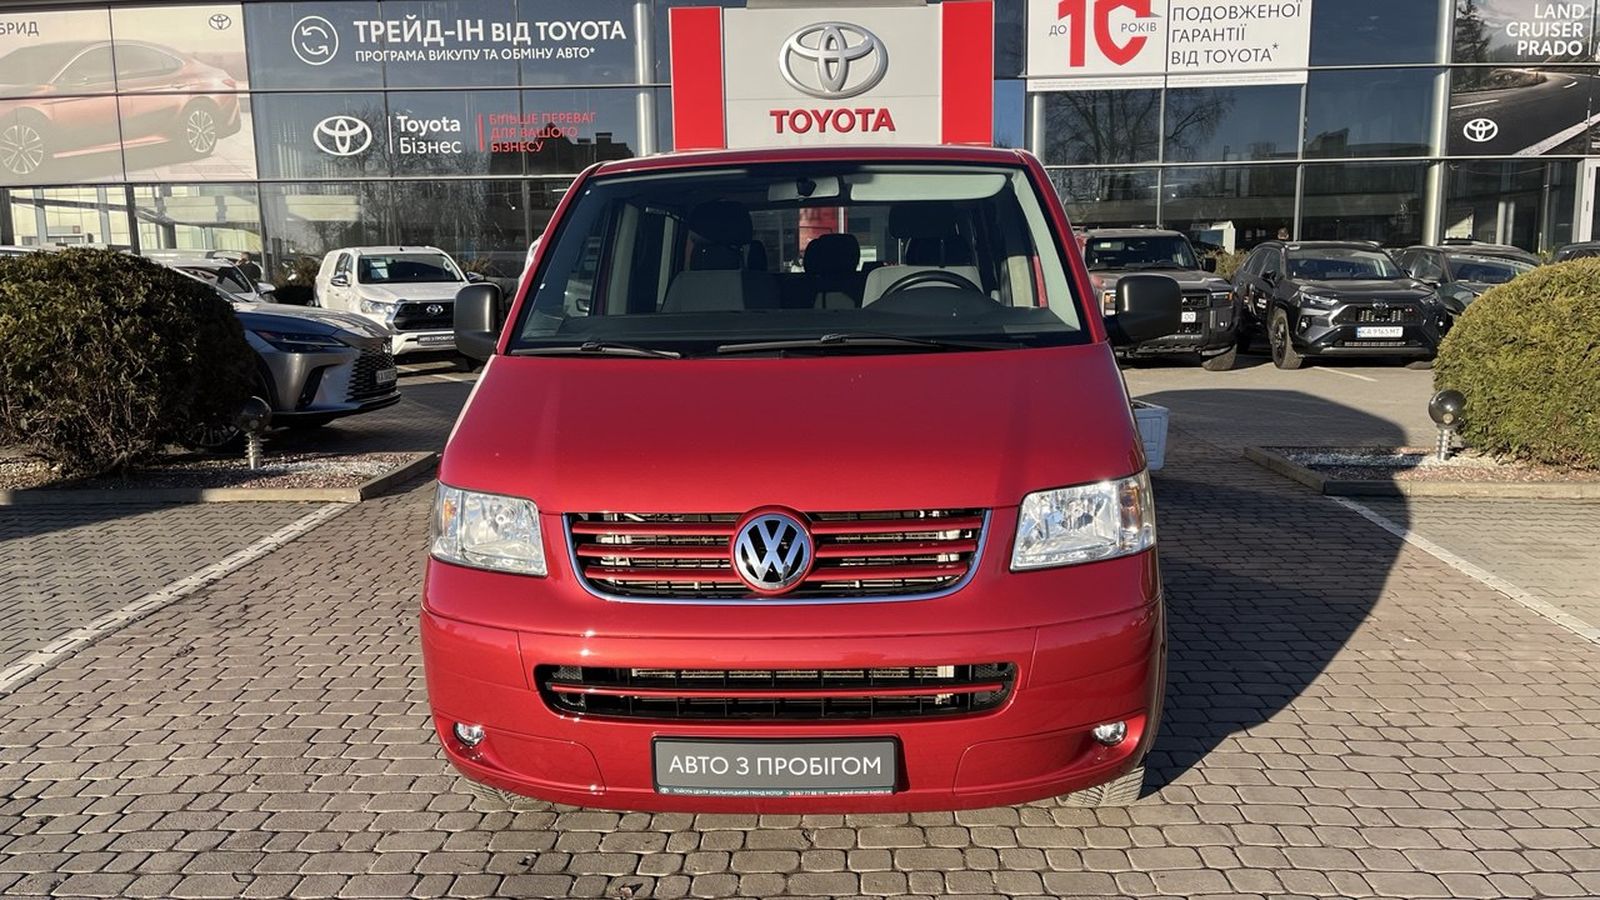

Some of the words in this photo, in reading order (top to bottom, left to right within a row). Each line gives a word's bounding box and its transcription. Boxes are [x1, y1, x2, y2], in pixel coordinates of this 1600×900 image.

[1173, 0, 1301, 22] ПОДОВЖЕНОЇ
[1534, 3, 1585, 19] LAND
[353, 14, 484, 47] ТРЕЙД-ІН
[491, 22, 532, 46] ВІД
[535, 20, 627, 41] TOYOTA
[1049, 24, 1067, 36] ДО
[1121, 22, 1157, 33] РОКІВ
[1172, 23, 1247, 42] ГАРАНТІЇ
[1506, 22, 1584, 37] CRUISER
[355, 50, 426, 62] ПРОГРАМА
[428, 49, 480, 61] ВИКУПУ
[482, 48, 499, 60] ТА
[500, 48, 554, 60] ОБМІНУ
[1517, 40, 1583, 55] PRADO
[1171, 50, 1199, 66] ВІД
[489, 113, 538, 124] БІЛЬШЕ
[542, 111, 596, 122] ПЕРЕВАГ
[769, 108, 896, 134] TOYOTA
[396, 116, 461, 136] Toyota
[491, 128, 516, 141] ДЛЯ
[520, 126, 578, 138] ВАШОГО
[400, 137, 462, 154] Бізнес
[491, 140, 544, 153] БІЗНЕСУ
[669, 756, 729, 774] АВТО
[757, 756, 882, 776] ПРОБІГОМ
